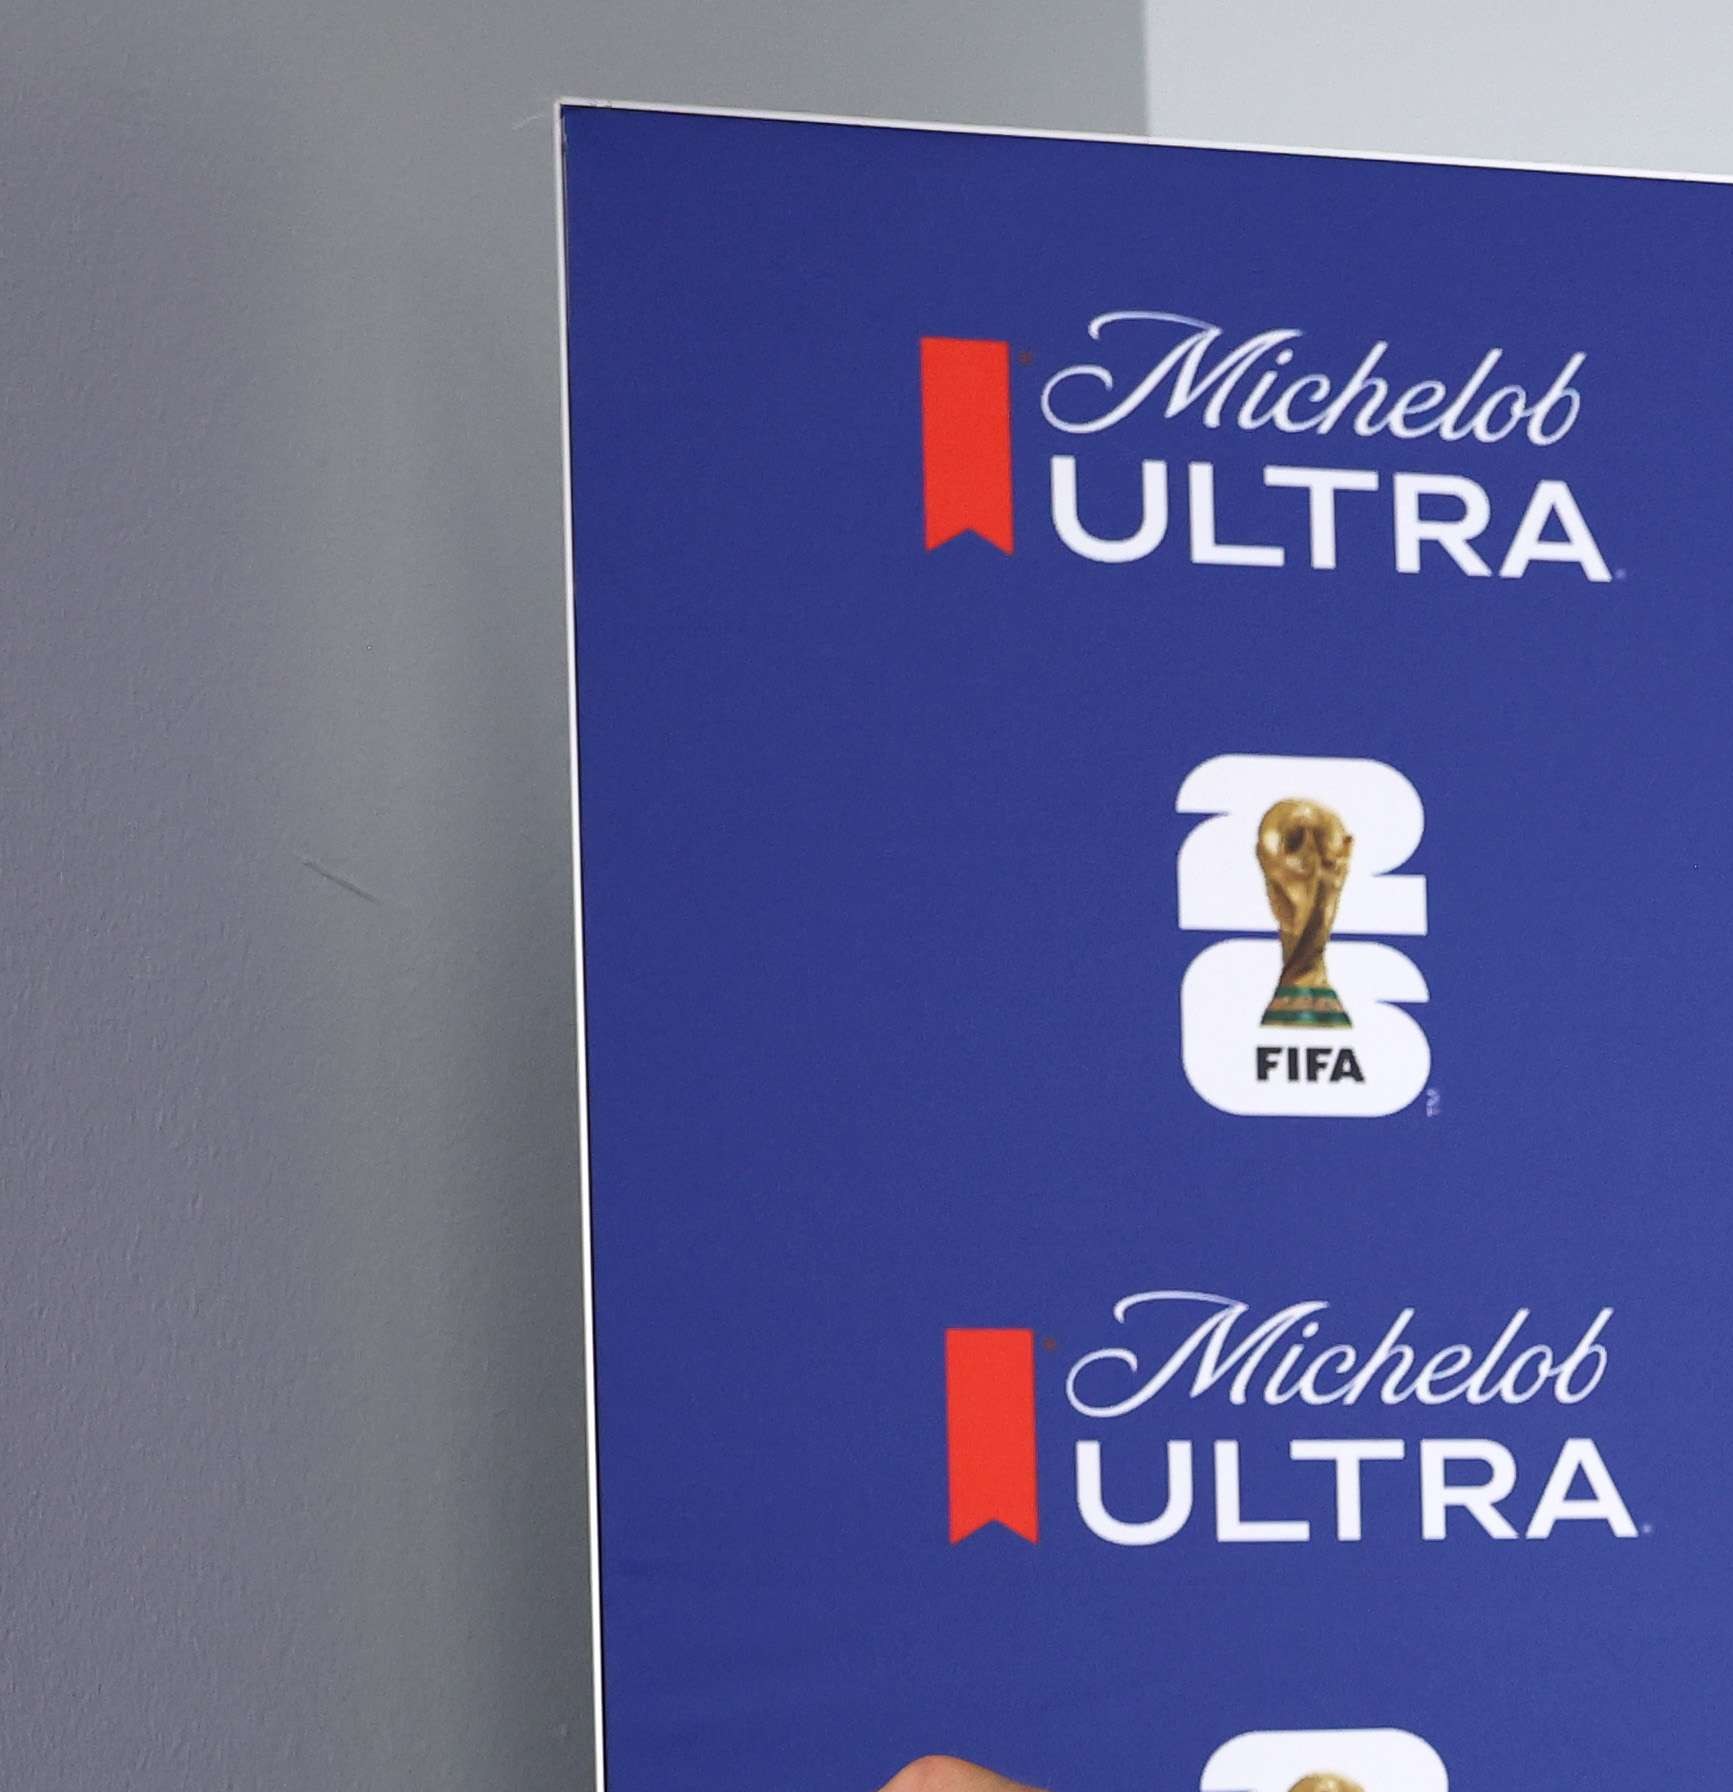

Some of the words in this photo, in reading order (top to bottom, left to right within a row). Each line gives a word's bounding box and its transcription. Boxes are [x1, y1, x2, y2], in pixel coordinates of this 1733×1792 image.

[1041, 311, 1586, 446] Michelob
[1050, 454, 1613, 582] ULTRA
[1255, 1045, 1365, 1083] FIFA
[1066, 1290, 1613, 1417] Michelob
[1075, 1437, 1638, 1546] ULTRA
